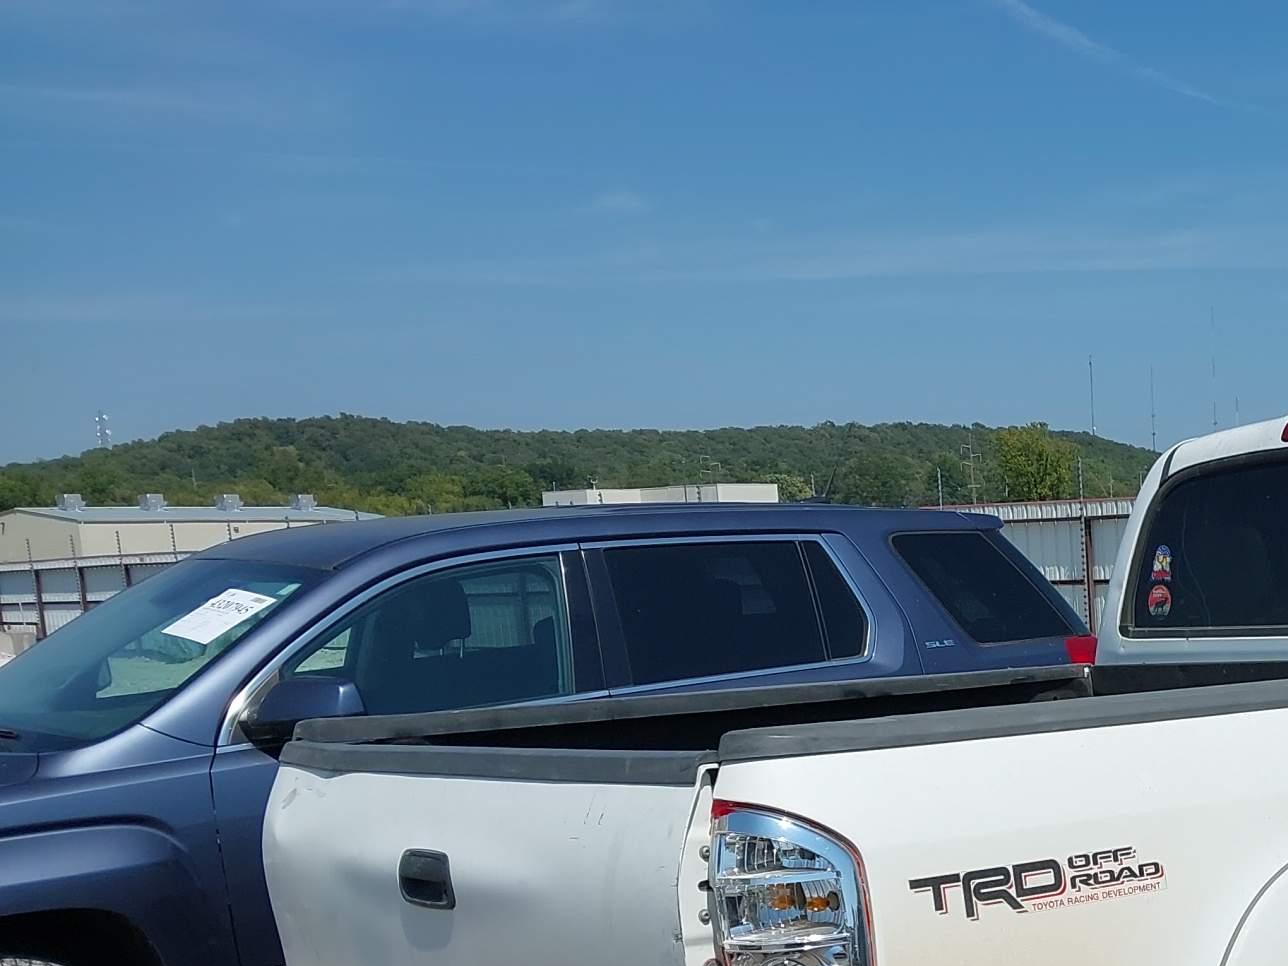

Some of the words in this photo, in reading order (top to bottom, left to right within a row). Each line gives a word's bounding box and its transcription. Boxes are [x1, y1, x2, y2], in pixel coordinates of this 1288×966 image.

[925, 639, 956, 650] SLE
[1067, 845, 1137, 870] OFF
[908, 858, 1067, 921] TRD
[1069, 861, 1166, 893] ROAD
[1031, 898, 1066, 913] TOYOTA
[1067, 892, 1100, 907] RACING
[1101, 881, 1162, 901] DEVELOPMENT
